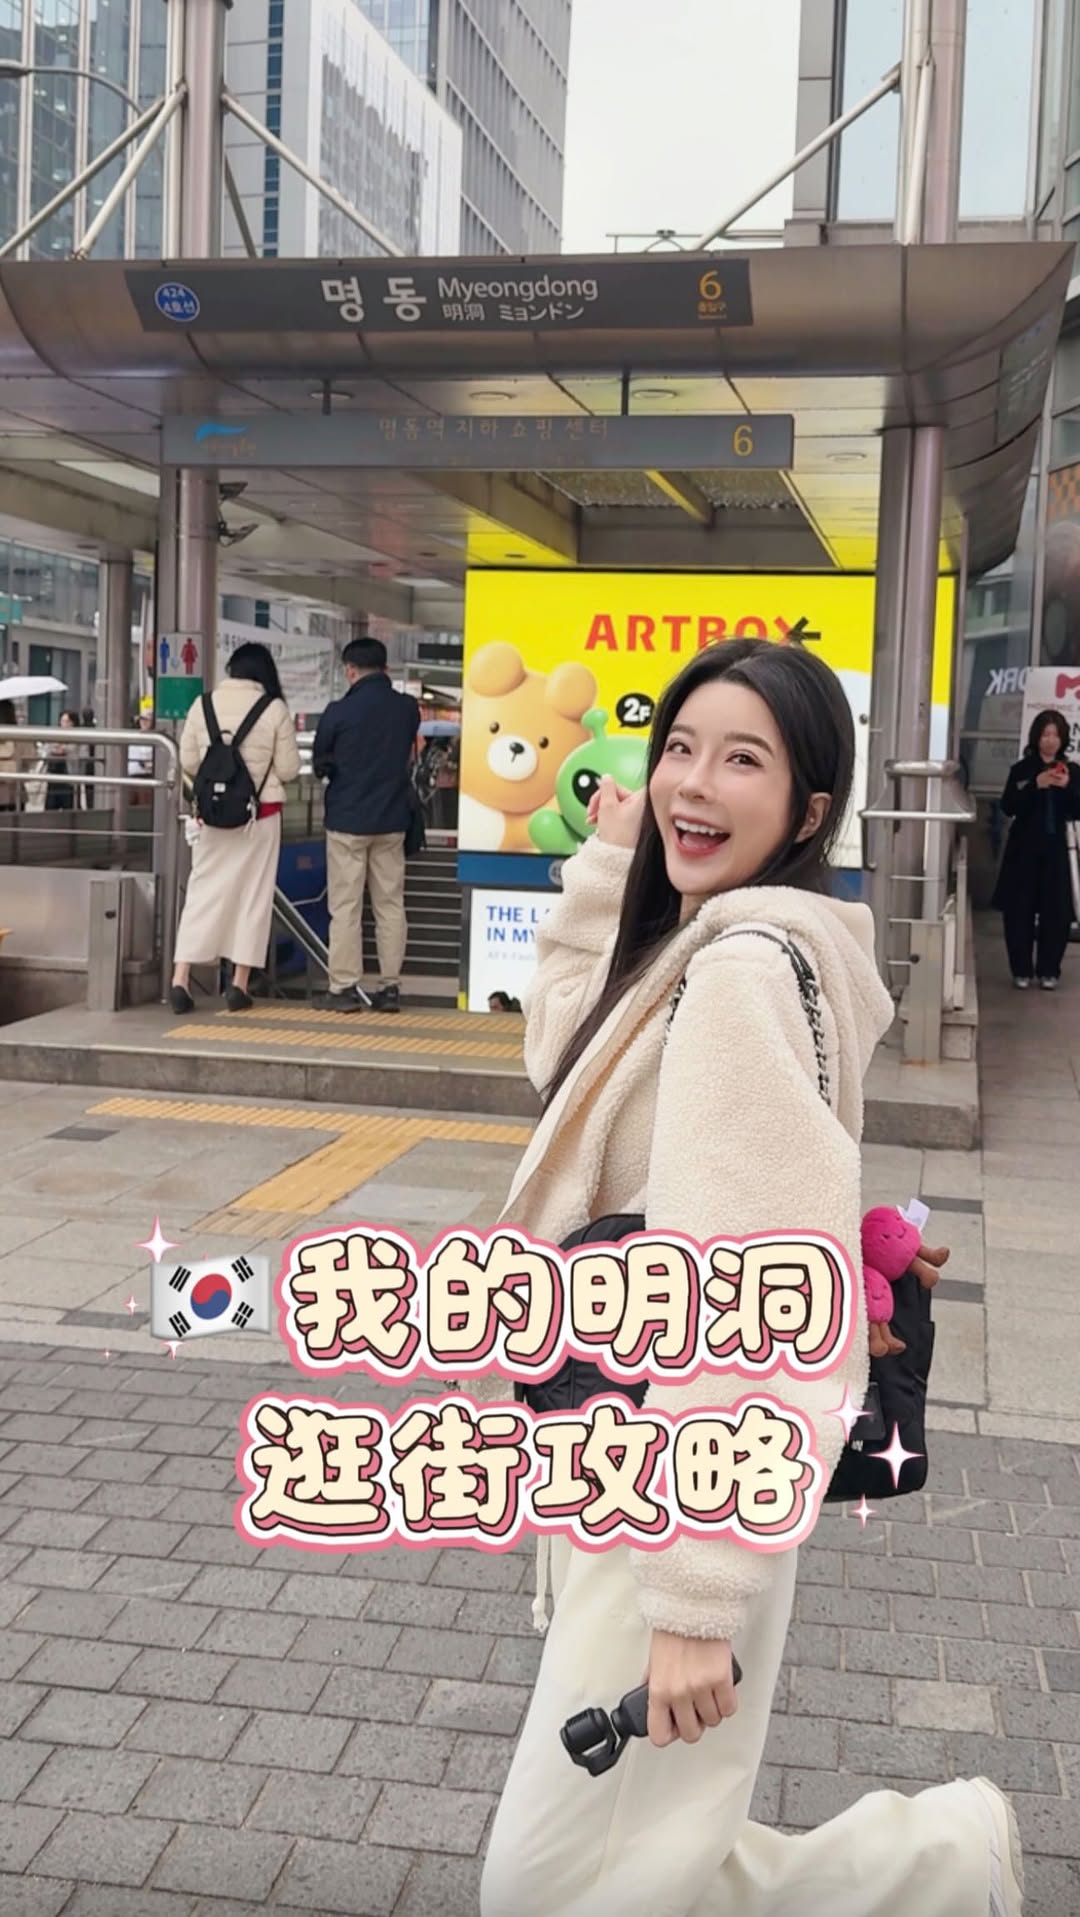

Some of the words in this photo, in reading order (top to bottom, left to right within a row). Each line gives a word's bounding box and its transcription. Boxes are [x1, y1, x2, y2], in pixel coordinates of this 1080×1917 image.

[437, 274, 599, 302] Myeongdong
[700, 270, 721, 300] 6
[442, 303, 485, 321] 明洞
[498, 301, 584, 321] ミョンドン
[734, 424, 753, 457] 6
[623, 697, 651, 722] 2F
[486, 905, 524, 923] THE
[486, 927, 506, 942] IN
